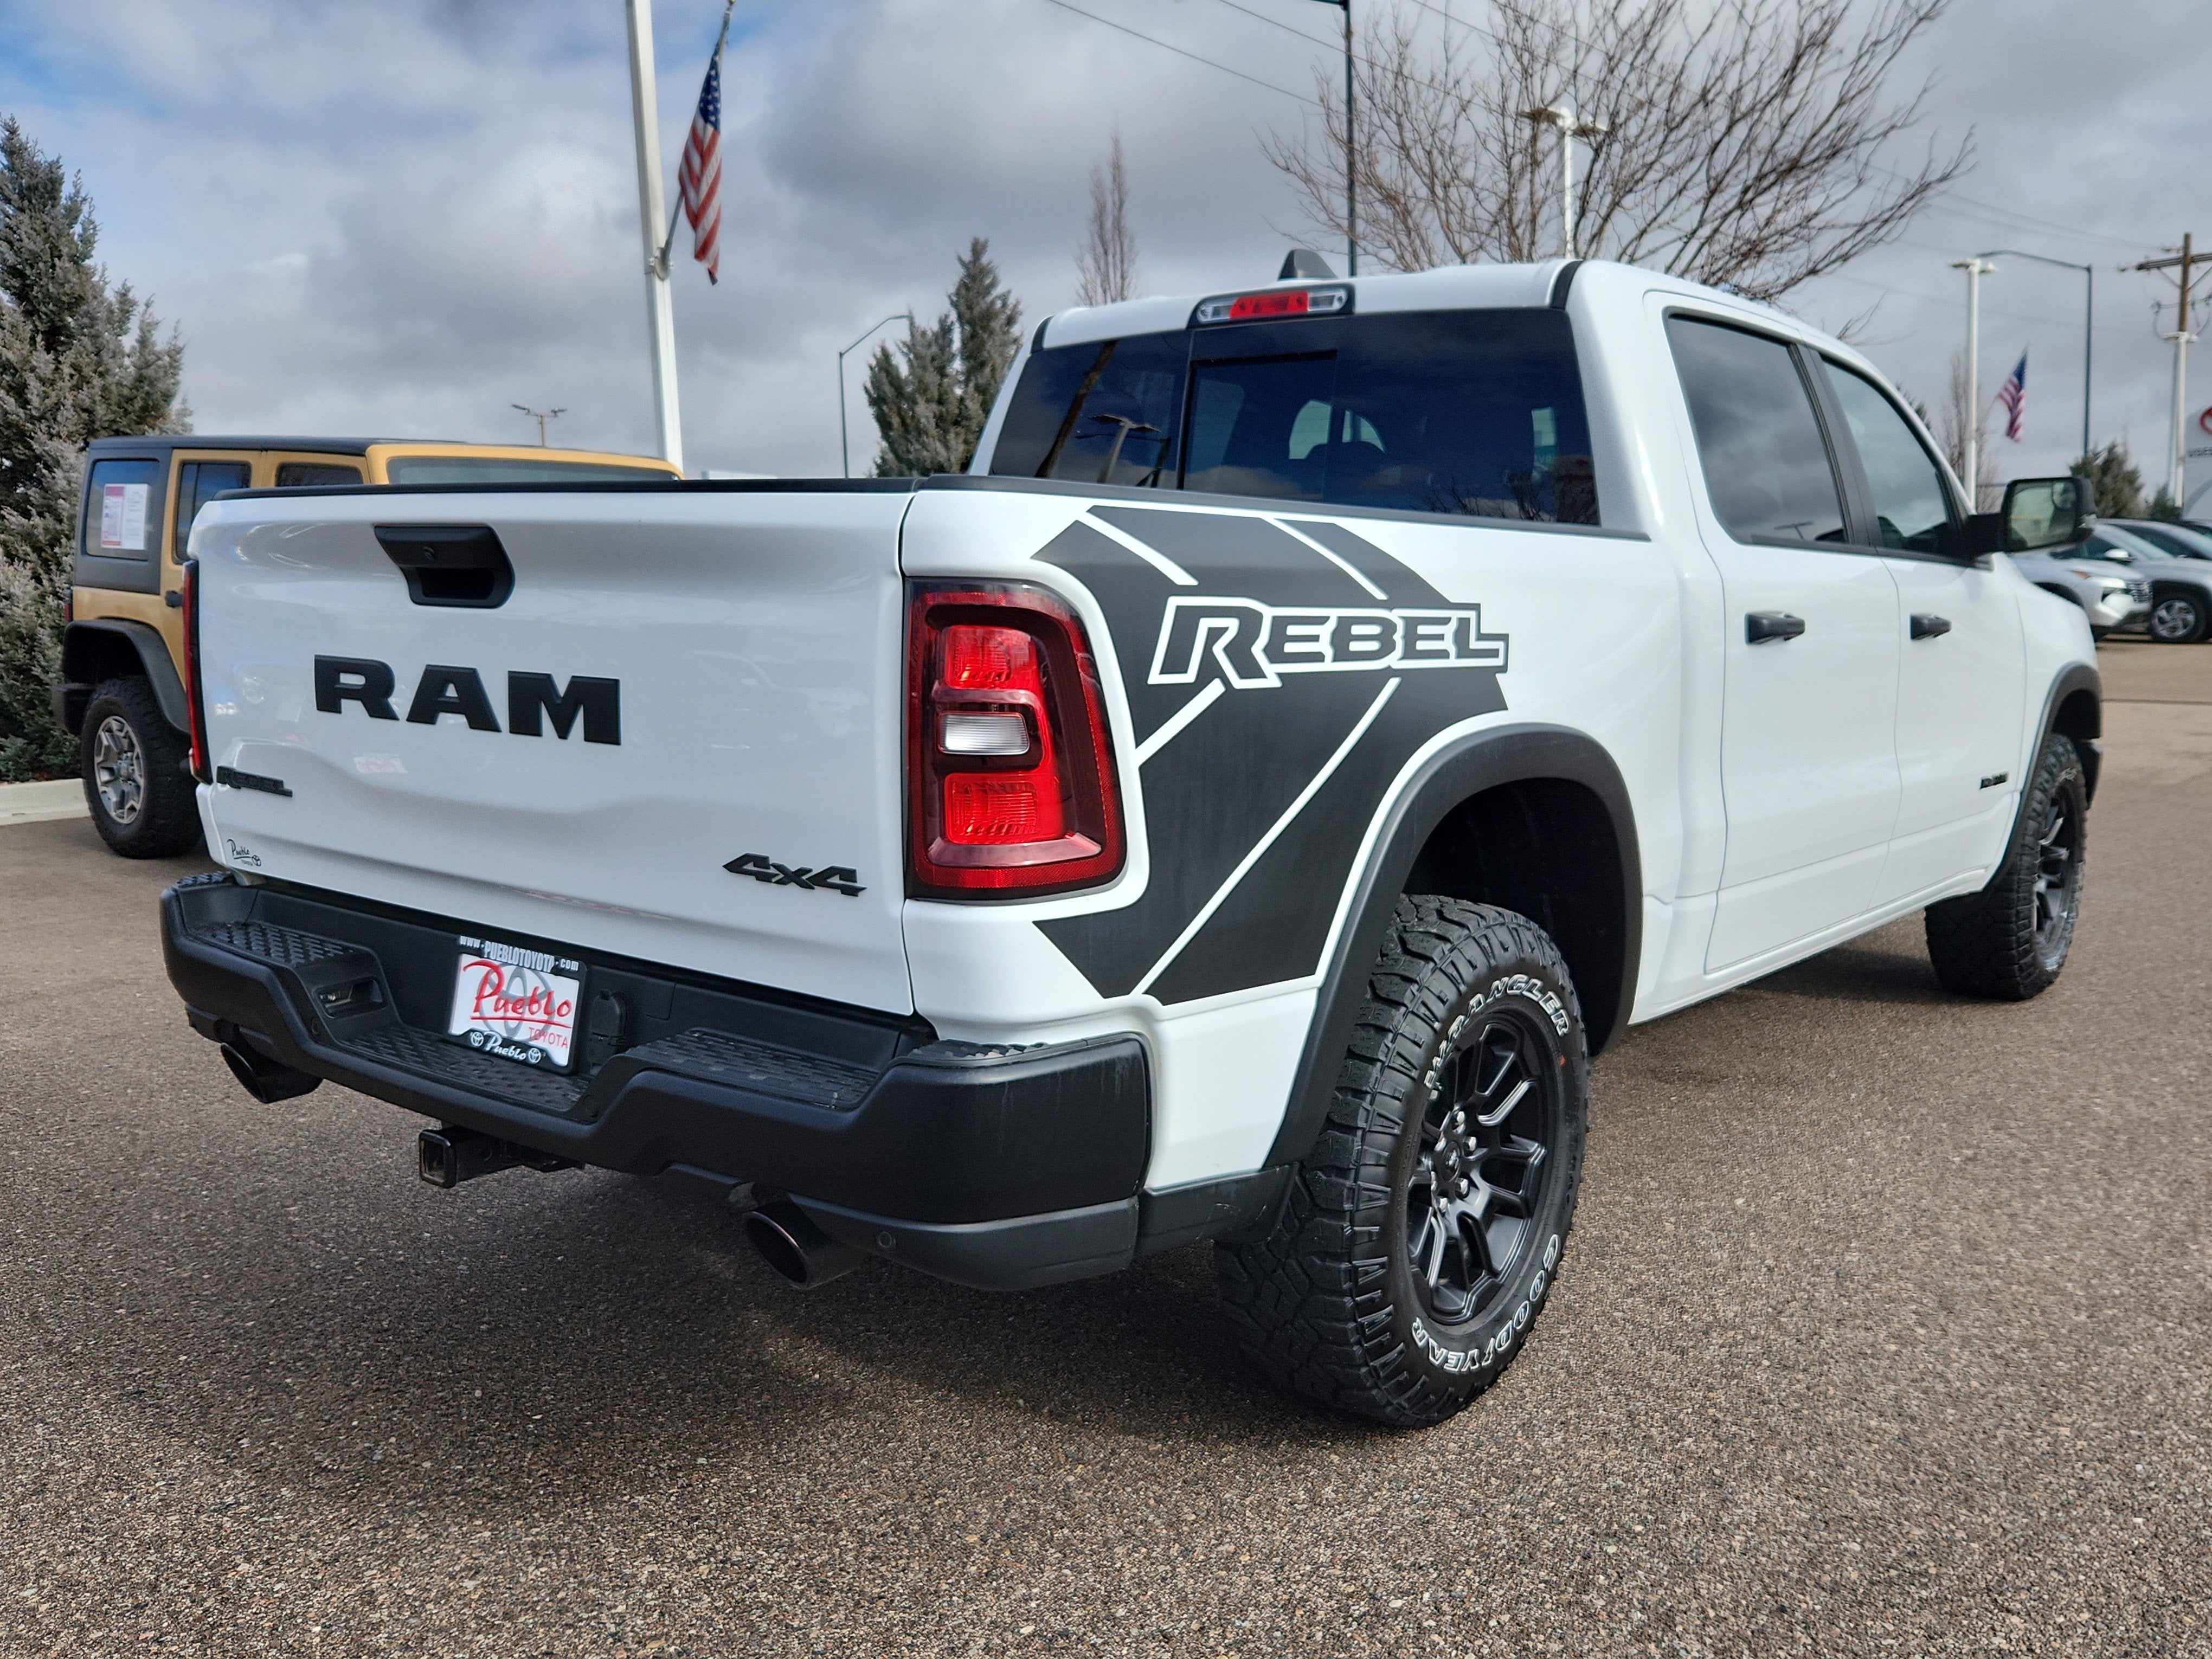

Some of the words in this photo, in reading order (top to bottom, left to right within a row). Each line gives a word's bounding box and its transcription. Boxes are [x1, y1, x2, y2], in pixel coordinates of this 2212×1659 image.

[1147, 595, 1508, 689] REBEL
[314, 654, 621, 745] RAM
[463, 960, 572, 1018] Pueblo
[483, 1031, 526, 1061] Pueblo
[528, 1026, 568, 1050] TOYOTA
[1411, 1234, 1560, 1374] GOODYEAR
